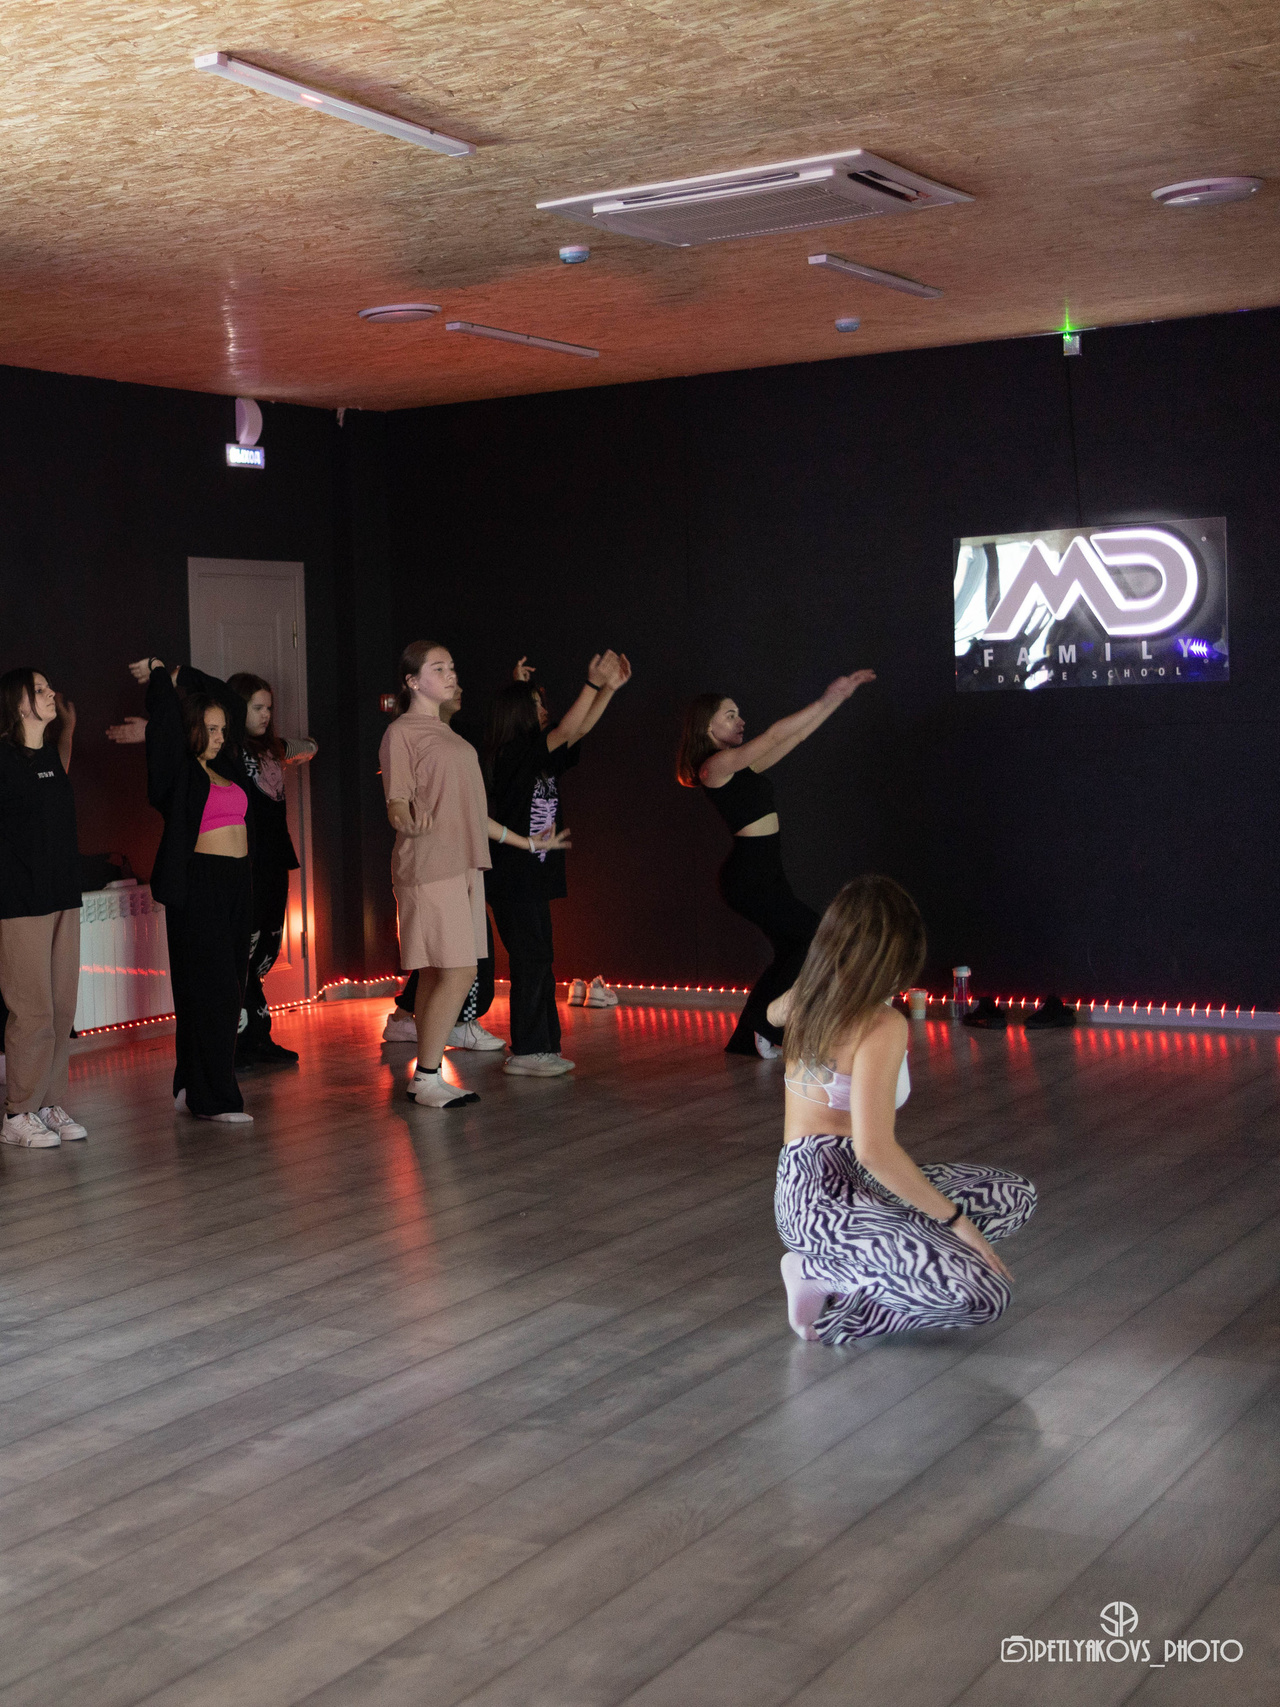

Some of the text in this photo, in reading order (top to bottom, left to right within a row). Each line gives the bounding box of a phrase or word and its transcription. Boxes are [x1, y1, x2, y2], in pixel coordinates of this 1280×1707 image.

[982, 529, 1198, 640] MD
[983, 638, 1192, 668] FAMILY
[1091, 666, 1182, 680] SCHOOL
